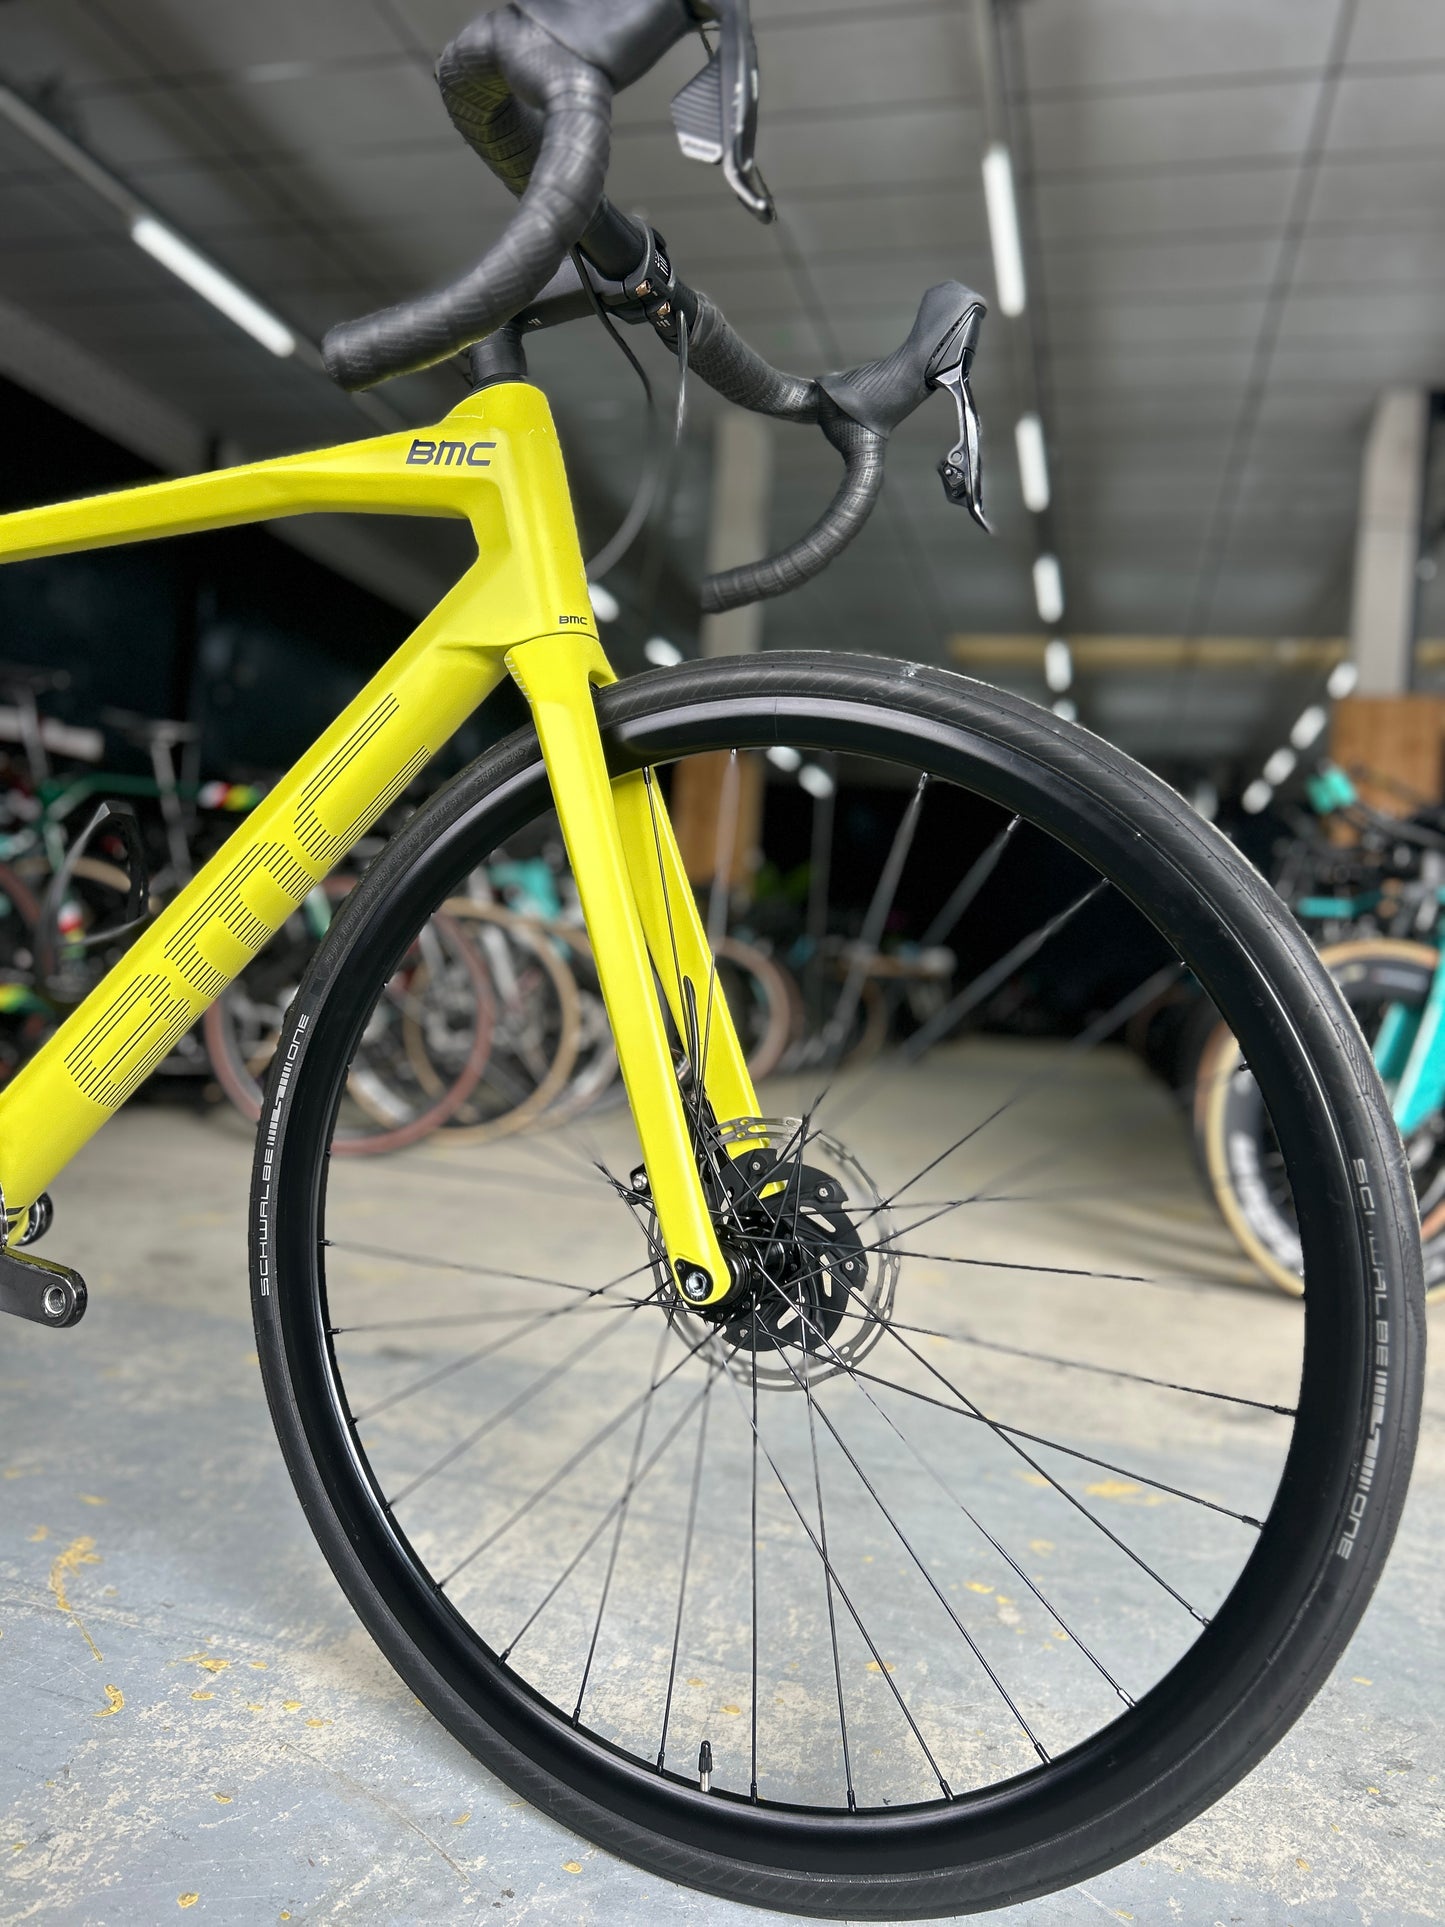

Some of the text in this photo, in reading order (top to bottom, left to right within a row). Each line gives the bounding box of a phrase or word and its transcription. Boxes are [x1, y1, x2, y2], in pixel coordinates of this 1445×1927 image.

[405, 439, 497, 466] BMC
[558, 615, 588, 626] BMC
[64, 692, 432, 1108] BMC
[259, 1013, 310, 1297] SCHWALBE ONE
[1336, 1495, 1368, 1560] ONE
